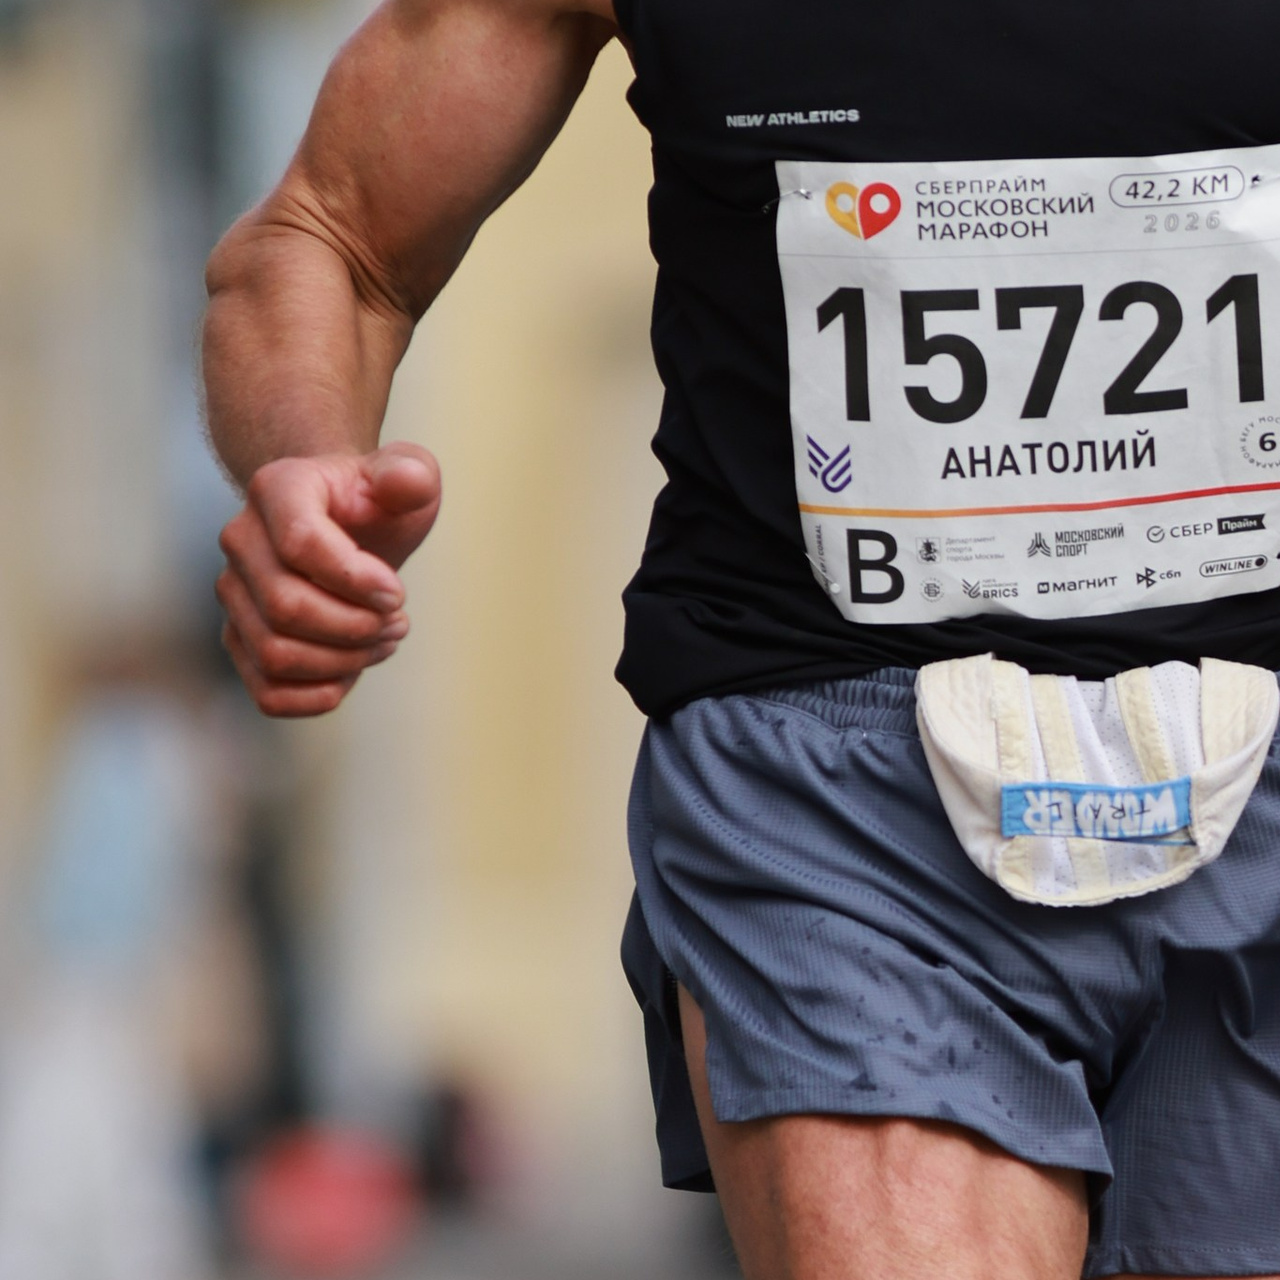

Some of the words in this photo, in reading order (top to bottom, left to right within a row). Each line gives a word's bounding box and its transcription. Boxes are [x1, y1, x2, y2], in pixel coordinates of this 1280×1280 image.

[726, 114, 764, 127] NEW
[767, 109, 860, 125] ATHLETICS
[915, 176, 1046, 195] СБЕРПРАЙМ
[1125, 179, 1180, 201] 42,2
[1192, 174, 1229, 196] КМ
[916, 193, 1094, 218] МОСКОВСКИЙ
[918, 220, 1048, 241] МАРАФОН
[1143, 210, 1220, 233] 2026
[815, 272, 1265, 425] 15721
[1259, 432, 1276, 452] 6
[941, 430, 1157, 479] АНАТОЛИЙ
[1055, 523, 1124, 543] МОСКОВСКИЙ
[1170, 523, 1213, 538] СБЕР
[1221, 518, 1258, 531] Прайм
[1056, 543, 1088, 557] СПОРТ
[1205, 560, 1252, 574] WINLINE
[983, 588, 1018, 598] BRICS
